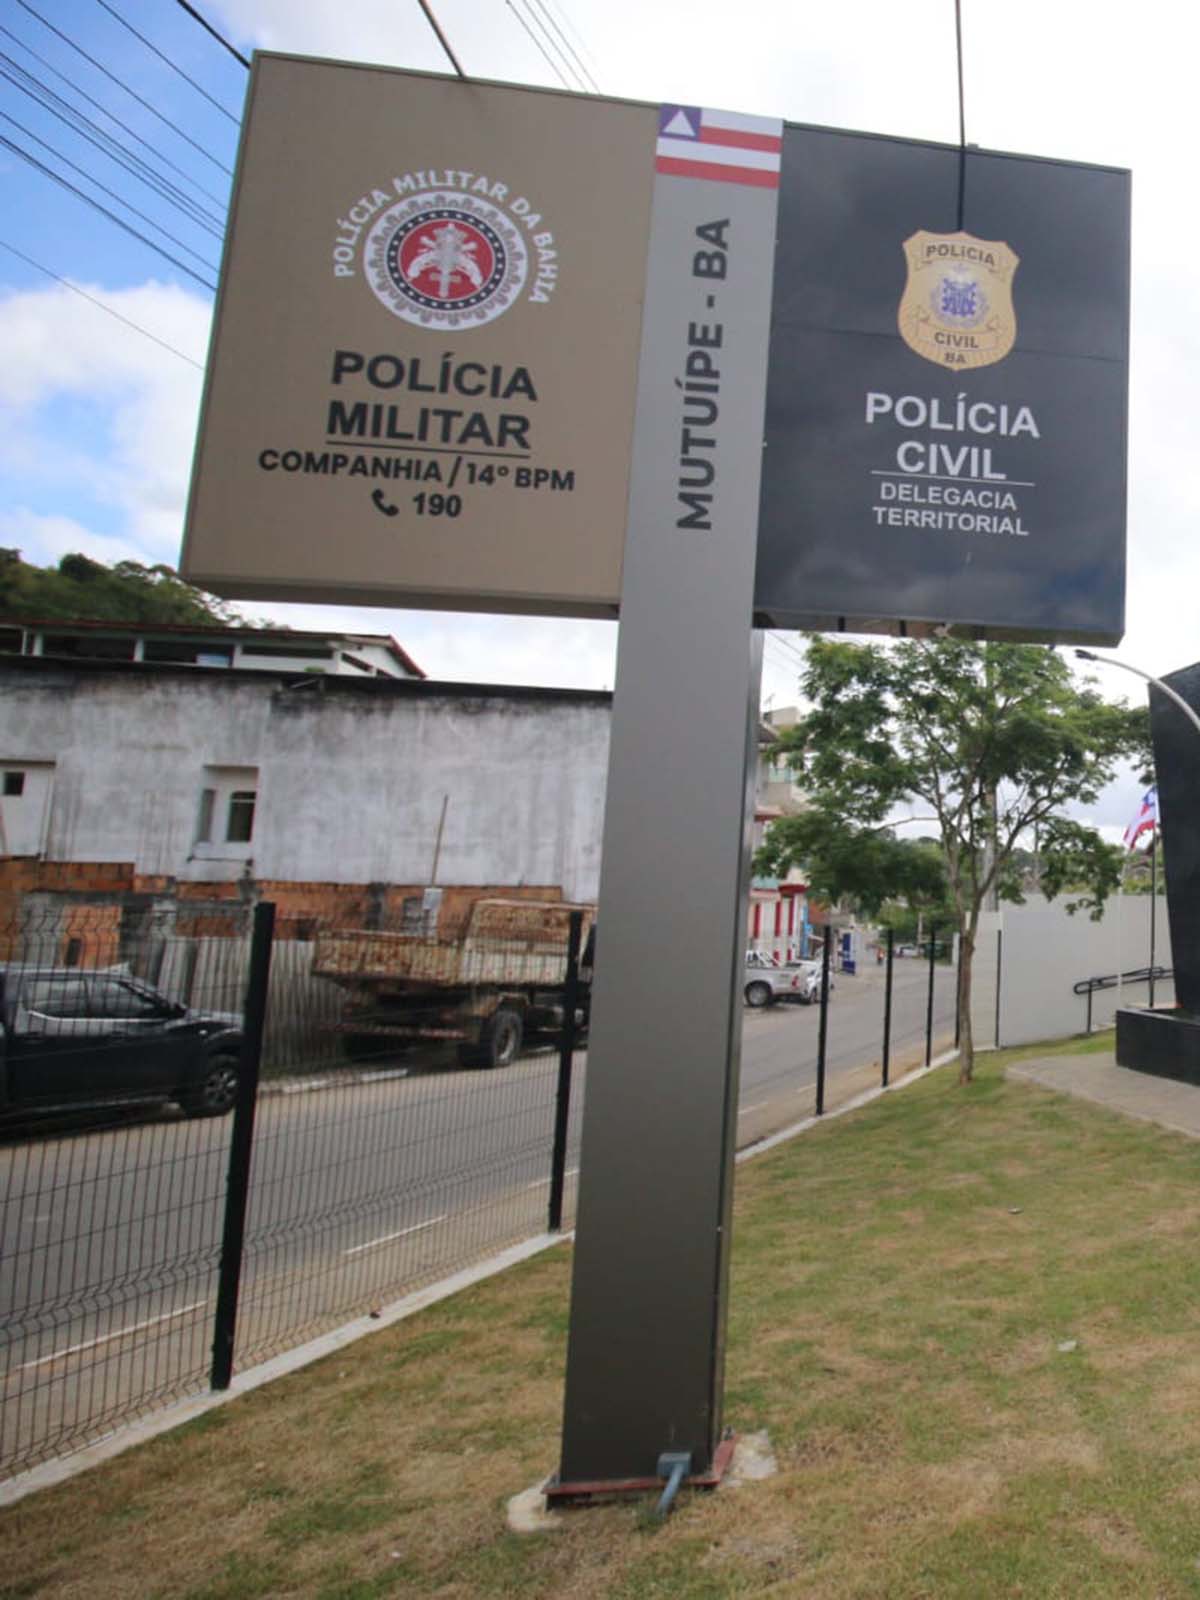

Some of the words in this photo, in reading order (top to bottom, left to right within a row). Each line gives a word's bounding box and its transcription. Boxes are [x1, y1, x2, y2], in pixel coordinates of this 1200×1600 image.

[333, 188, 392, 278] POLÍCIA
[392, 169, 509, 202] MILITAR
[509, 196, 542, 230] DA
[528, 231, 558, 303] BAHIA
[691, 217, 731, 281] BA
[934, 331, 979, 349] CIVIL
[944, 352, 967, 364] BA
[331, 350, 539, 402] POLÍCIA
[326, 399, 532, 450] MILITAR
[675, 320, 723, 531] MUTUÍPE
[865, 391, 1041, 440] POLÍCIA
[514, 467, 576, 491] BPM
[896, 440, 1008, 481] CIVIL
[412, 492, 462, 518] 190
[879, 481, 1019, 512] DELEGACIA
[872, 506, 1031, 537] TERRITORIAL
